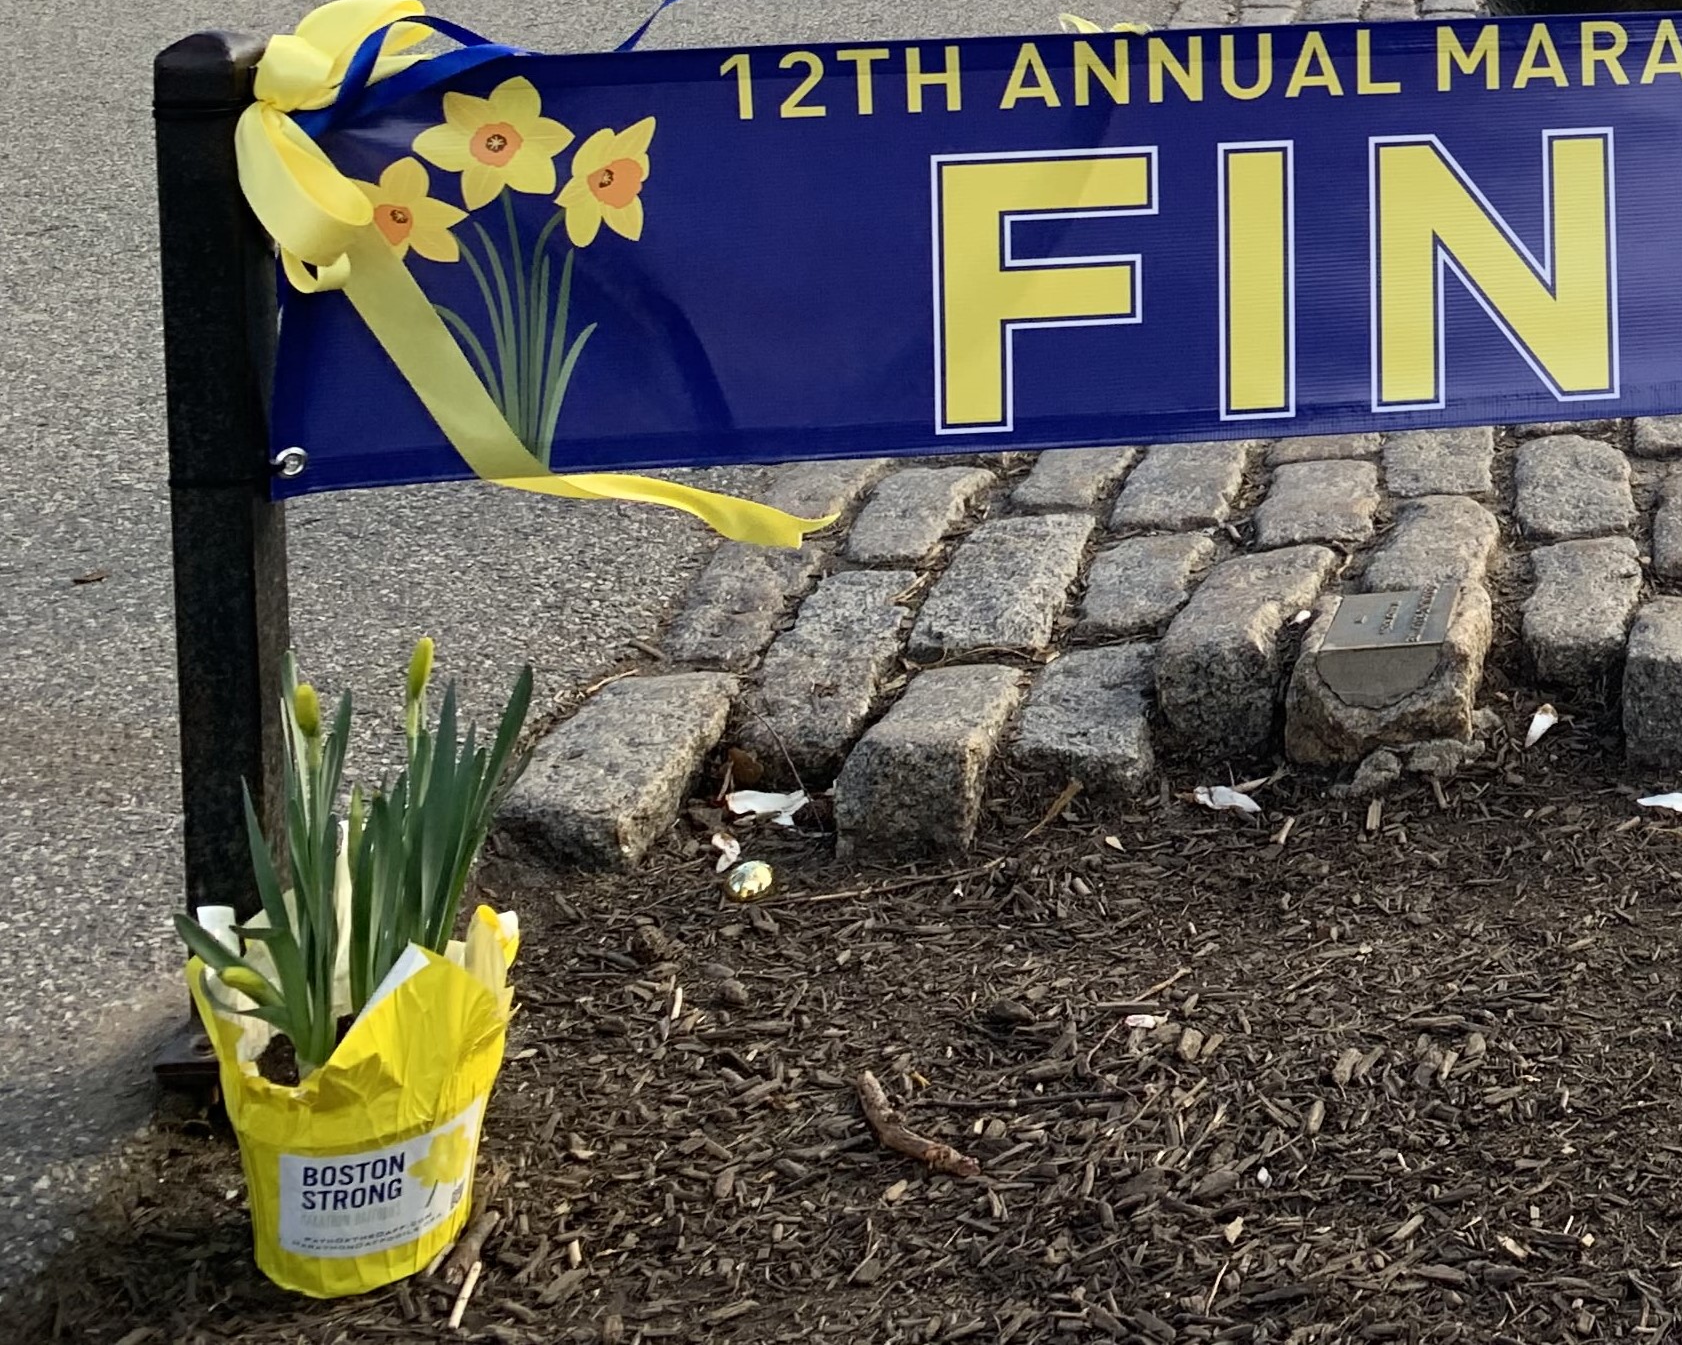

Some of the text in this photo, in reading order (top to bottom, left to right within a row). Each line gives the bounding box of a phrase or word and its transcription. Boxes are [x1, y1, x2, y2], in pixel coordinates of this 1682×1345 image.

[719, 46, 961, 120] 12TH
[1000, 29, 1402, 110] ANNUAL
[303, 1152, 405, 1186] BOSTON
[302, 1178, 402, 1211] STRONG
